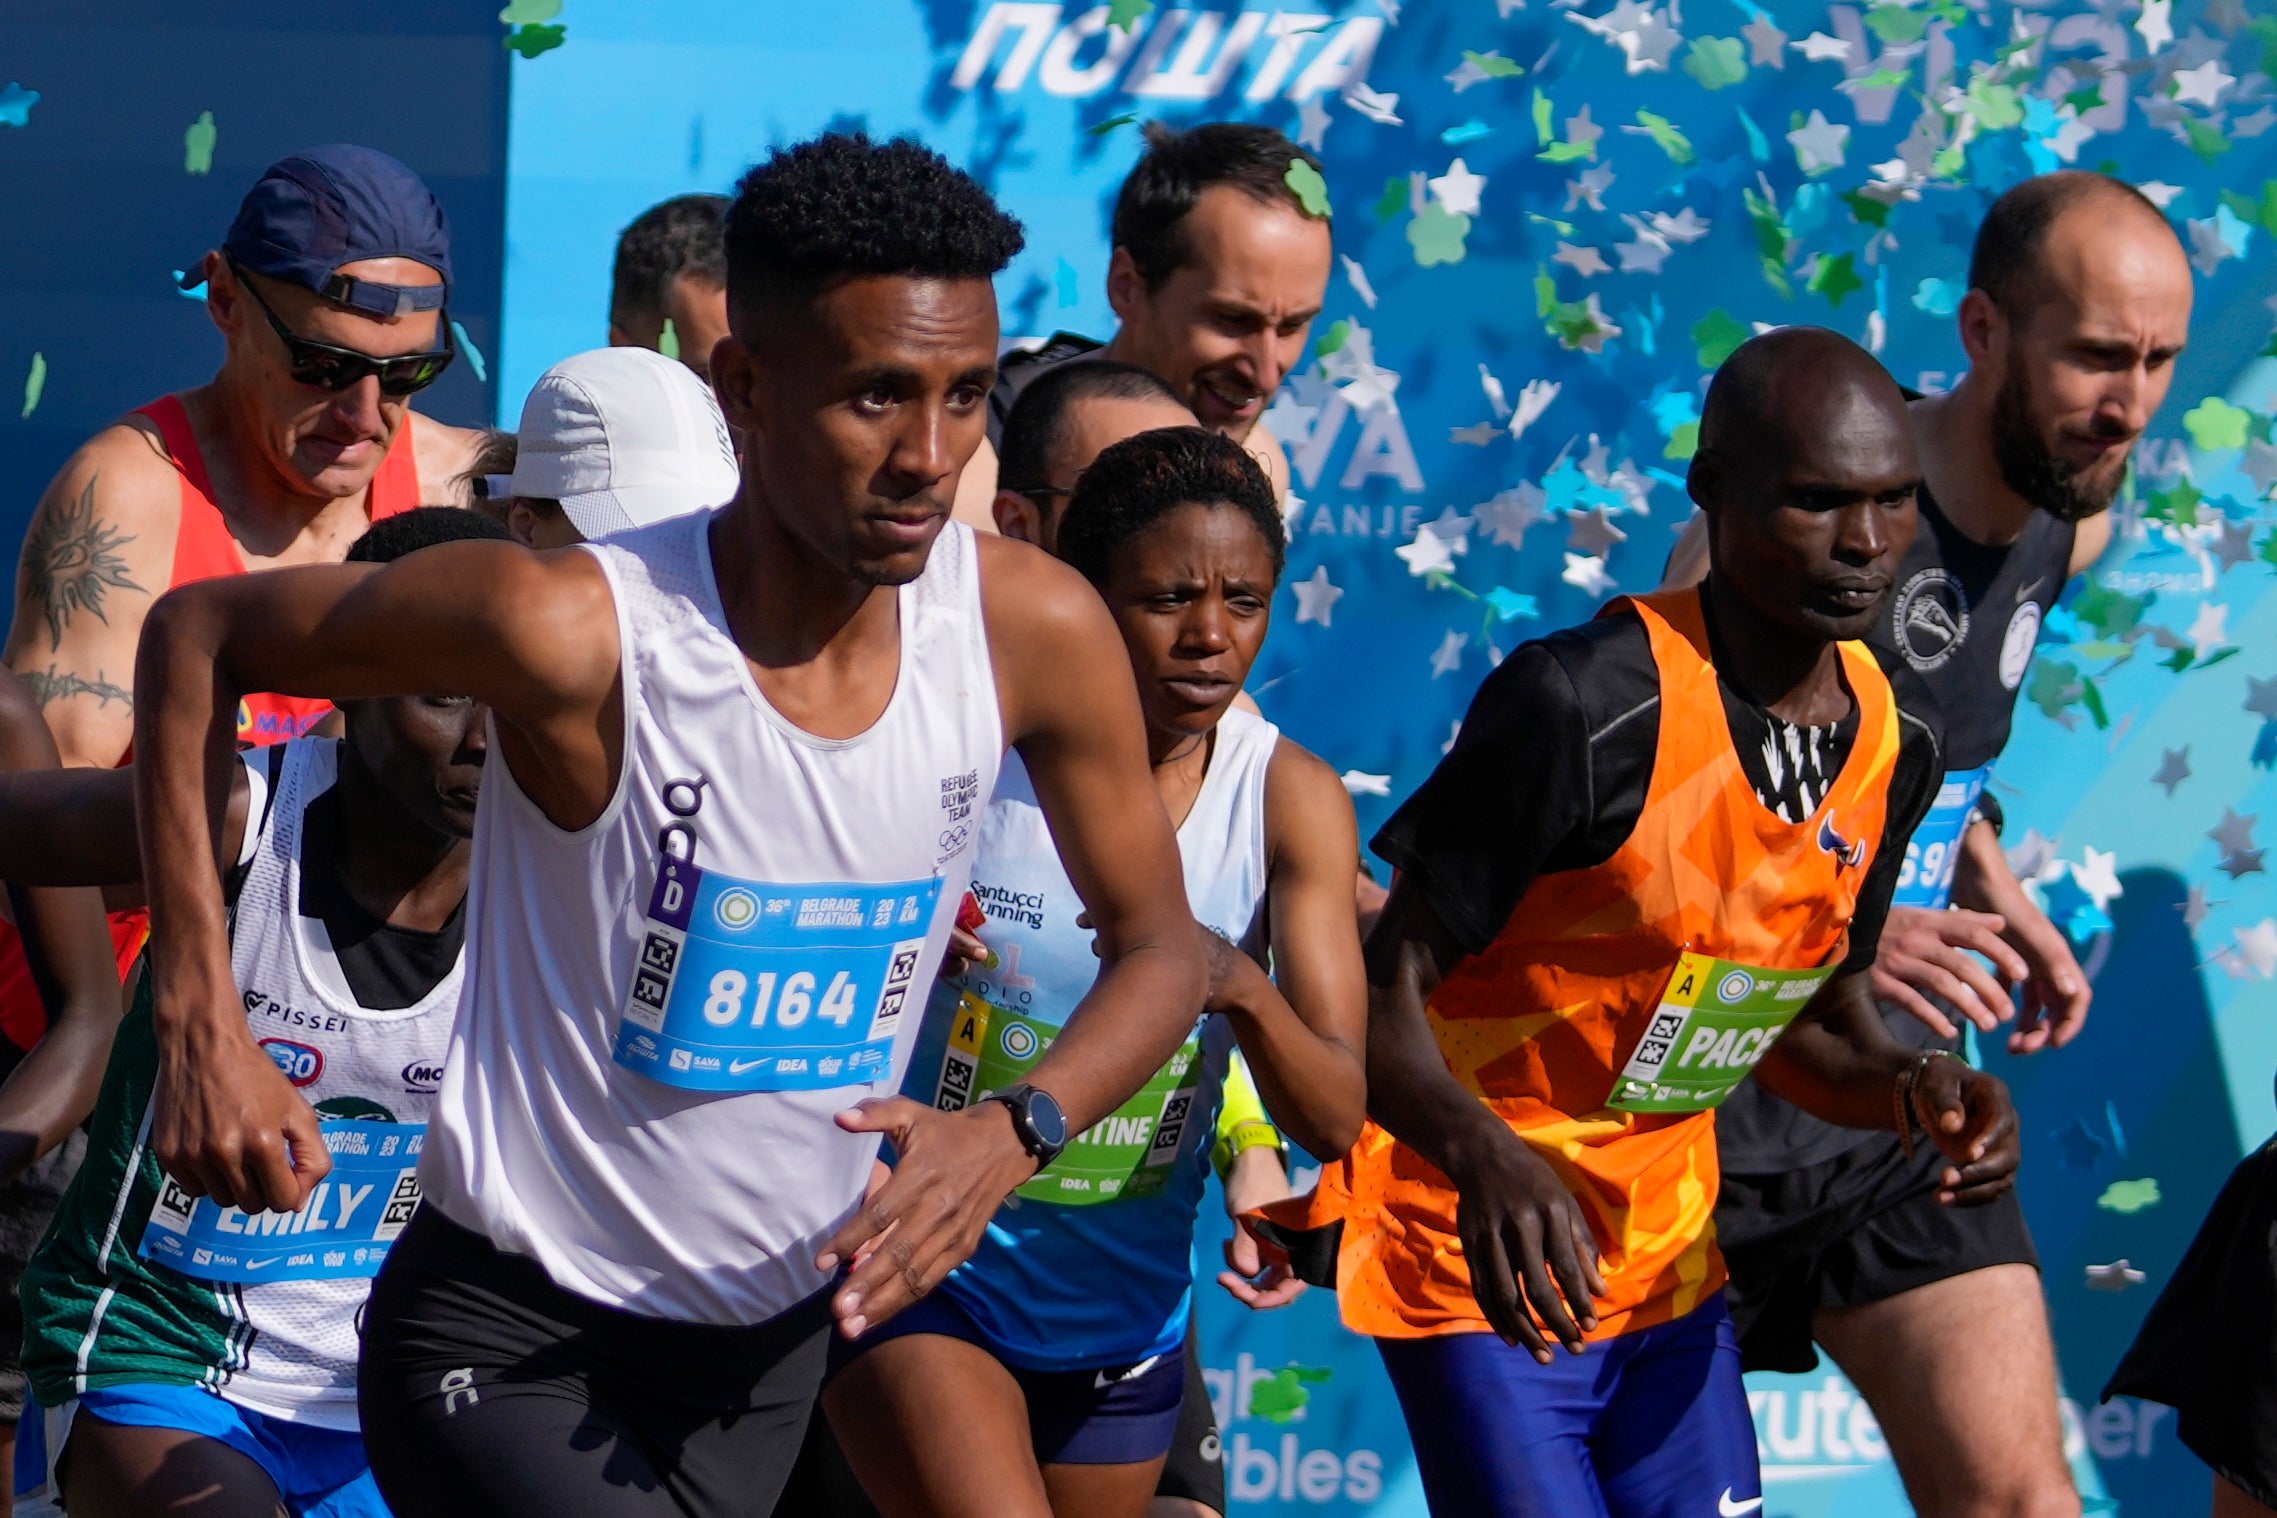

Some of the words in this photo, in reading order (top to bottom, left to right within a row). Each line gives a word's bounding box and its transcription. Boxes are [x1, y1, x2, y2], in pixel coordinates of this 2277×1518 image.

[950, 2, 1384, 100] ПОШТА
[948, 803, 971, 822] TEAM
[662, 879, 684, 912] D
[800, 898, 860, 913] BELGRADE
[876, 899, 895, 912] 20
[796, 912, 864, 927] MARATHON
[872, 912, 890, 926] 23
[899, 907, 919, 922] KM
[979, 902, 1044, 930] unning
[1677, 974, 1695, 996] A
[703, 969, 857, 1030] 8164
[266, 1002, 347, 1032] PISSEI
[960, 1017, 974, 1042] A
[693, 1055, 720, 1067] SAVA
[776, 1059, 808, 1072] IDEA
[1075, 1115, 1154, 1146] TINE
[1060, 1177, 1091, 1191] IDEA
[286, 1253, 314, 1266] IDEA
[1224, 1433, 1383, 1503] bles
